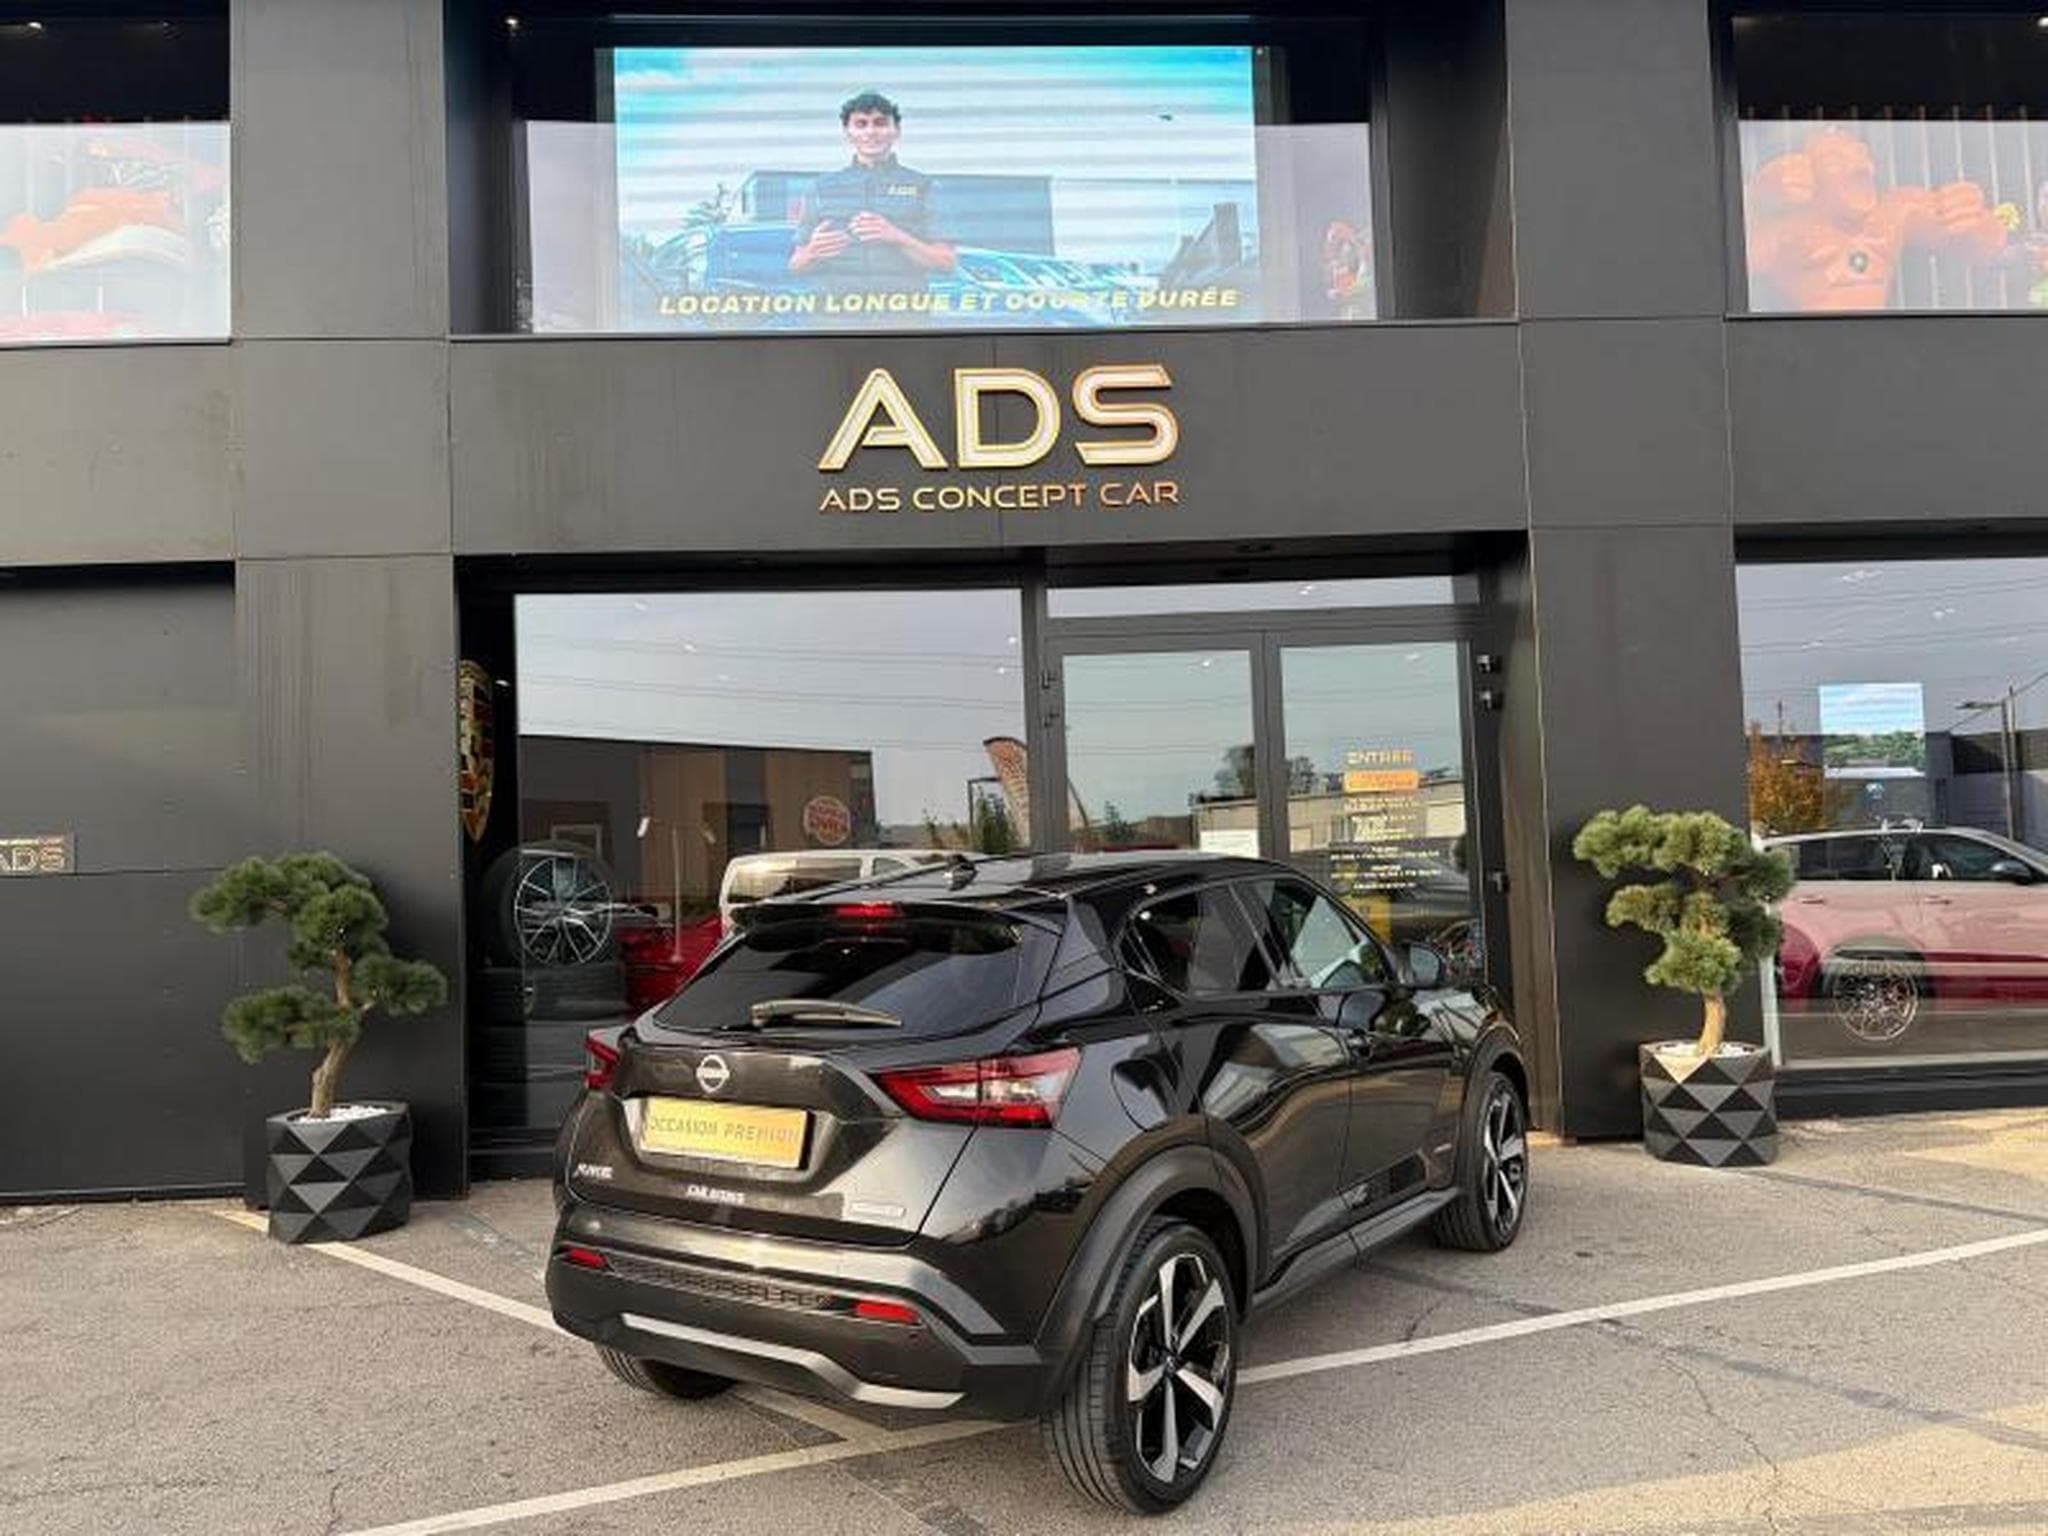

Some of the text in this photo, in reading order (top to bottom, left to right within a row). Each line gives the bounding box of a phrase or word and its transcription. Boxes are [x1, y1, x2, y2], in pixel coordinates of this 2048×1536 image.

[659, 294, 816, 315] LOCATION
[824, 292, 951, 313] LONGUE
[959, 292, 993, 311] ET
[1138, 286, 1238, 308] DURÉE
[818, 364, 1180, 471] ADS
[819, 481, 1180, 512] ADS CONCEPT CAR
